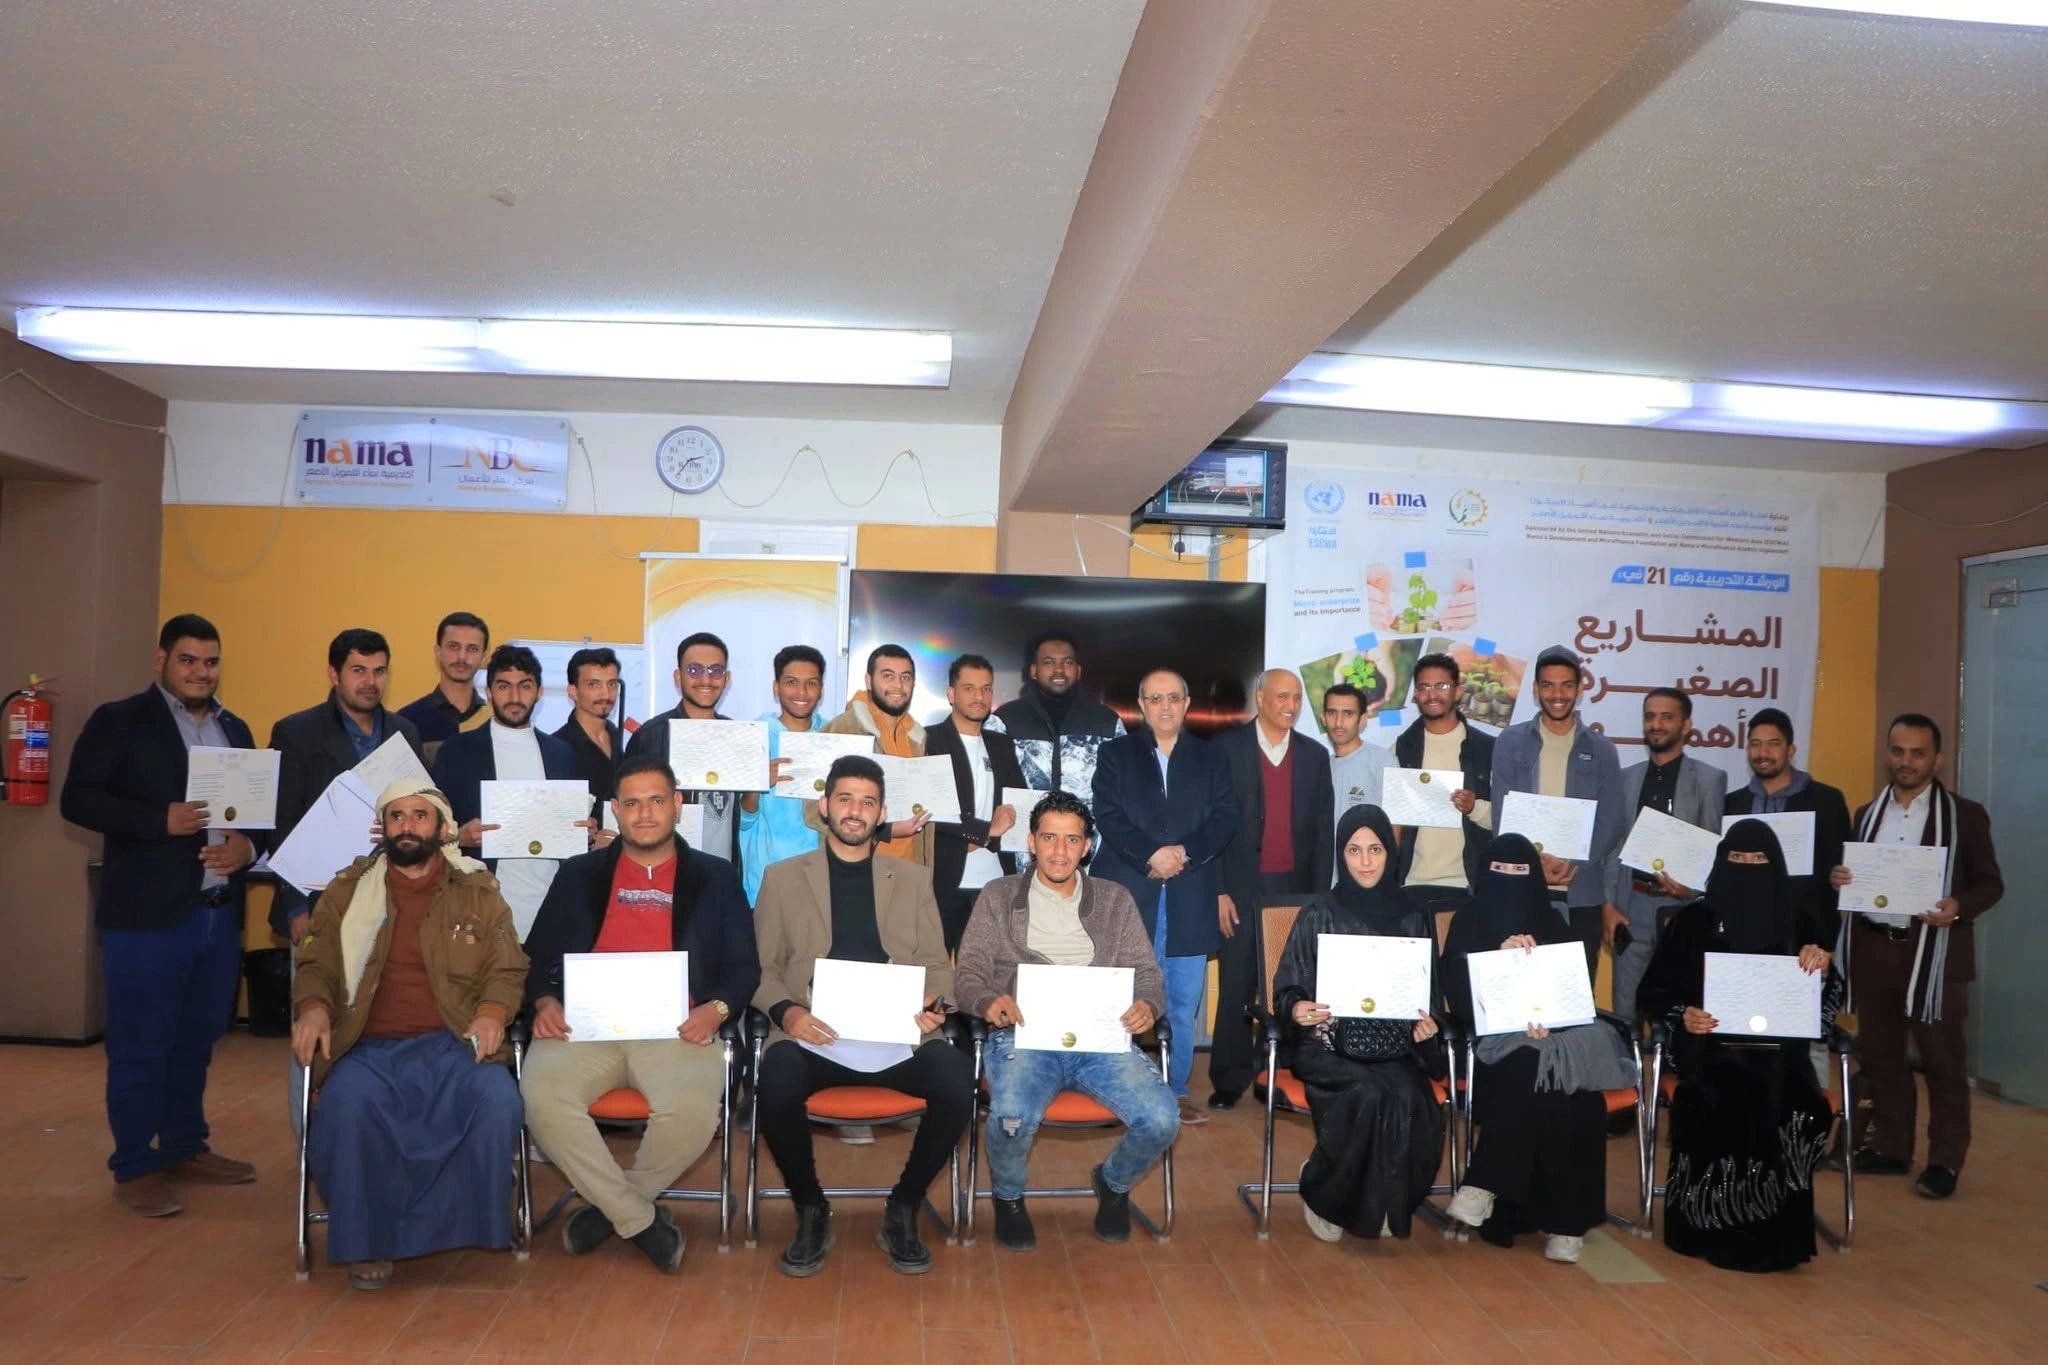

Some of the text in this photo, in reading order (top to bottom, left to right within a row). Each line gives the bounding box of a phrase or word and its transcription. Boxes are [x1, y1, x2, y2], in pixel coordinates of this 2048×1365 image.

[303, 437, 414, 467] nama
[1368, 491, 1427, 508] nama
[1309, 538, 1337, 549] ESCWA
[1647, 566, 1666, 585] 21
[1294, 608, 1307, 616] and
[1574, 609, 1782, 654] المشاريع
